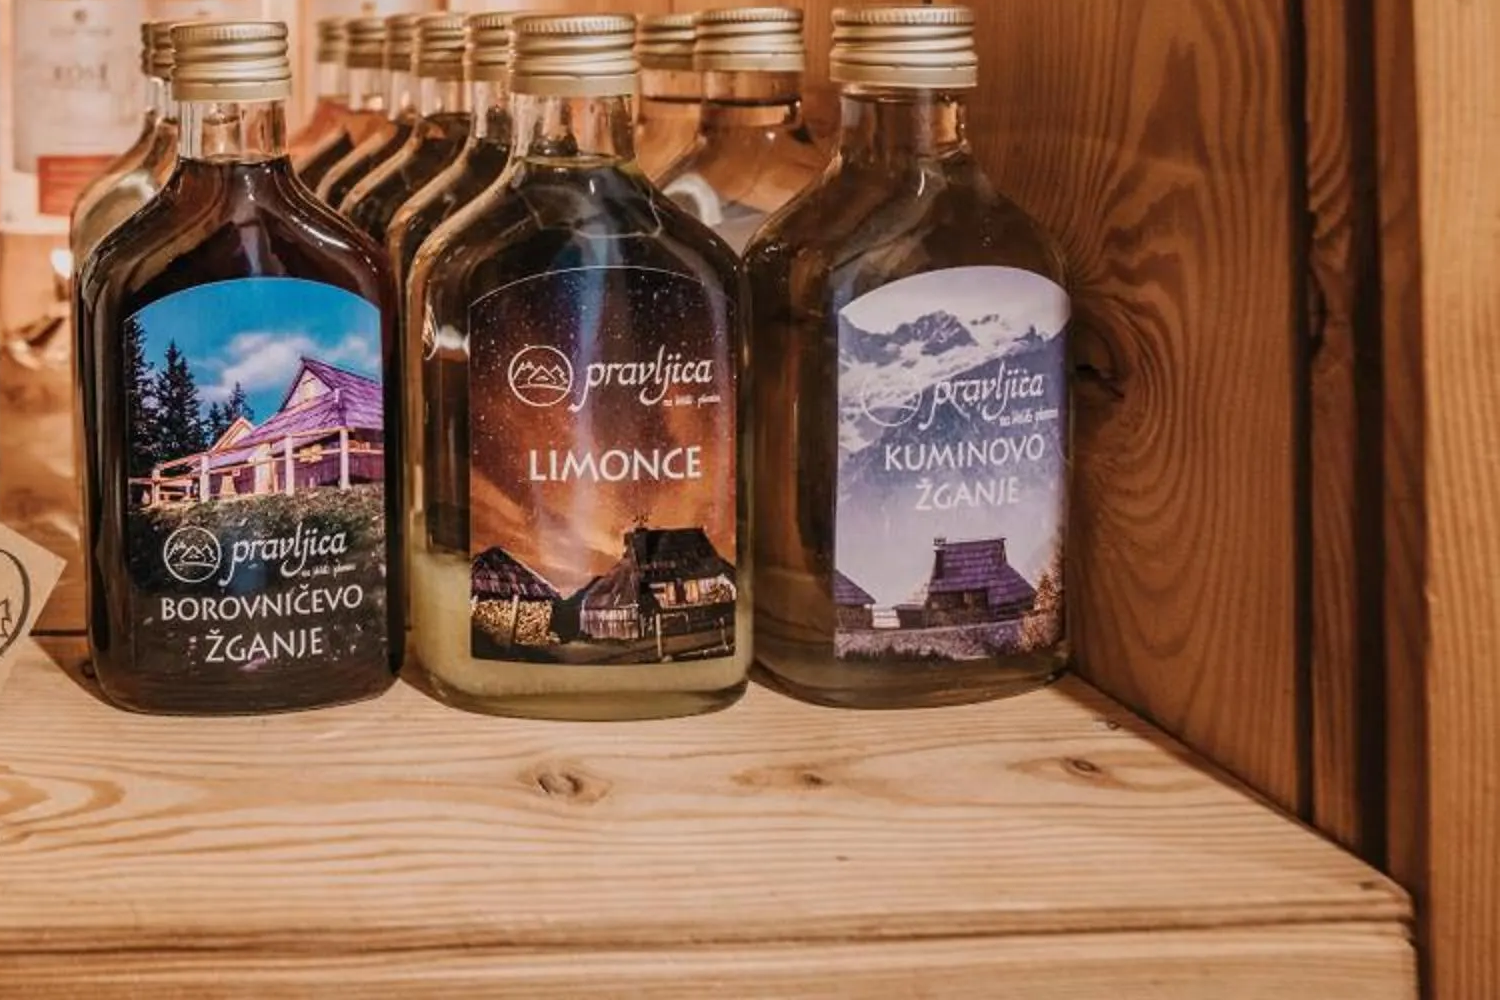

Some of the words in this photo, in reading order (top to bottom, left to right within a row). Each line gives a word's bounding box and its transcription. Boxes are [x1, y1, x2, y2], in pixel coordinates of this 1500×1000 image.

[568, 344, 714, 412] pravljica
[918, 360, 1045, 431] pravljica
[530, 445, 703, 482] LIMONCE
[885, 434, 1045, 471] KUMINOVO
[916, 477, 1020, 511] ŽGANJE
[218, 521, 349, 586] pravljica
[161, 584, 364, 621] BOROVNIČEVO
[205, 627, 323, 663] ŽGANJE
